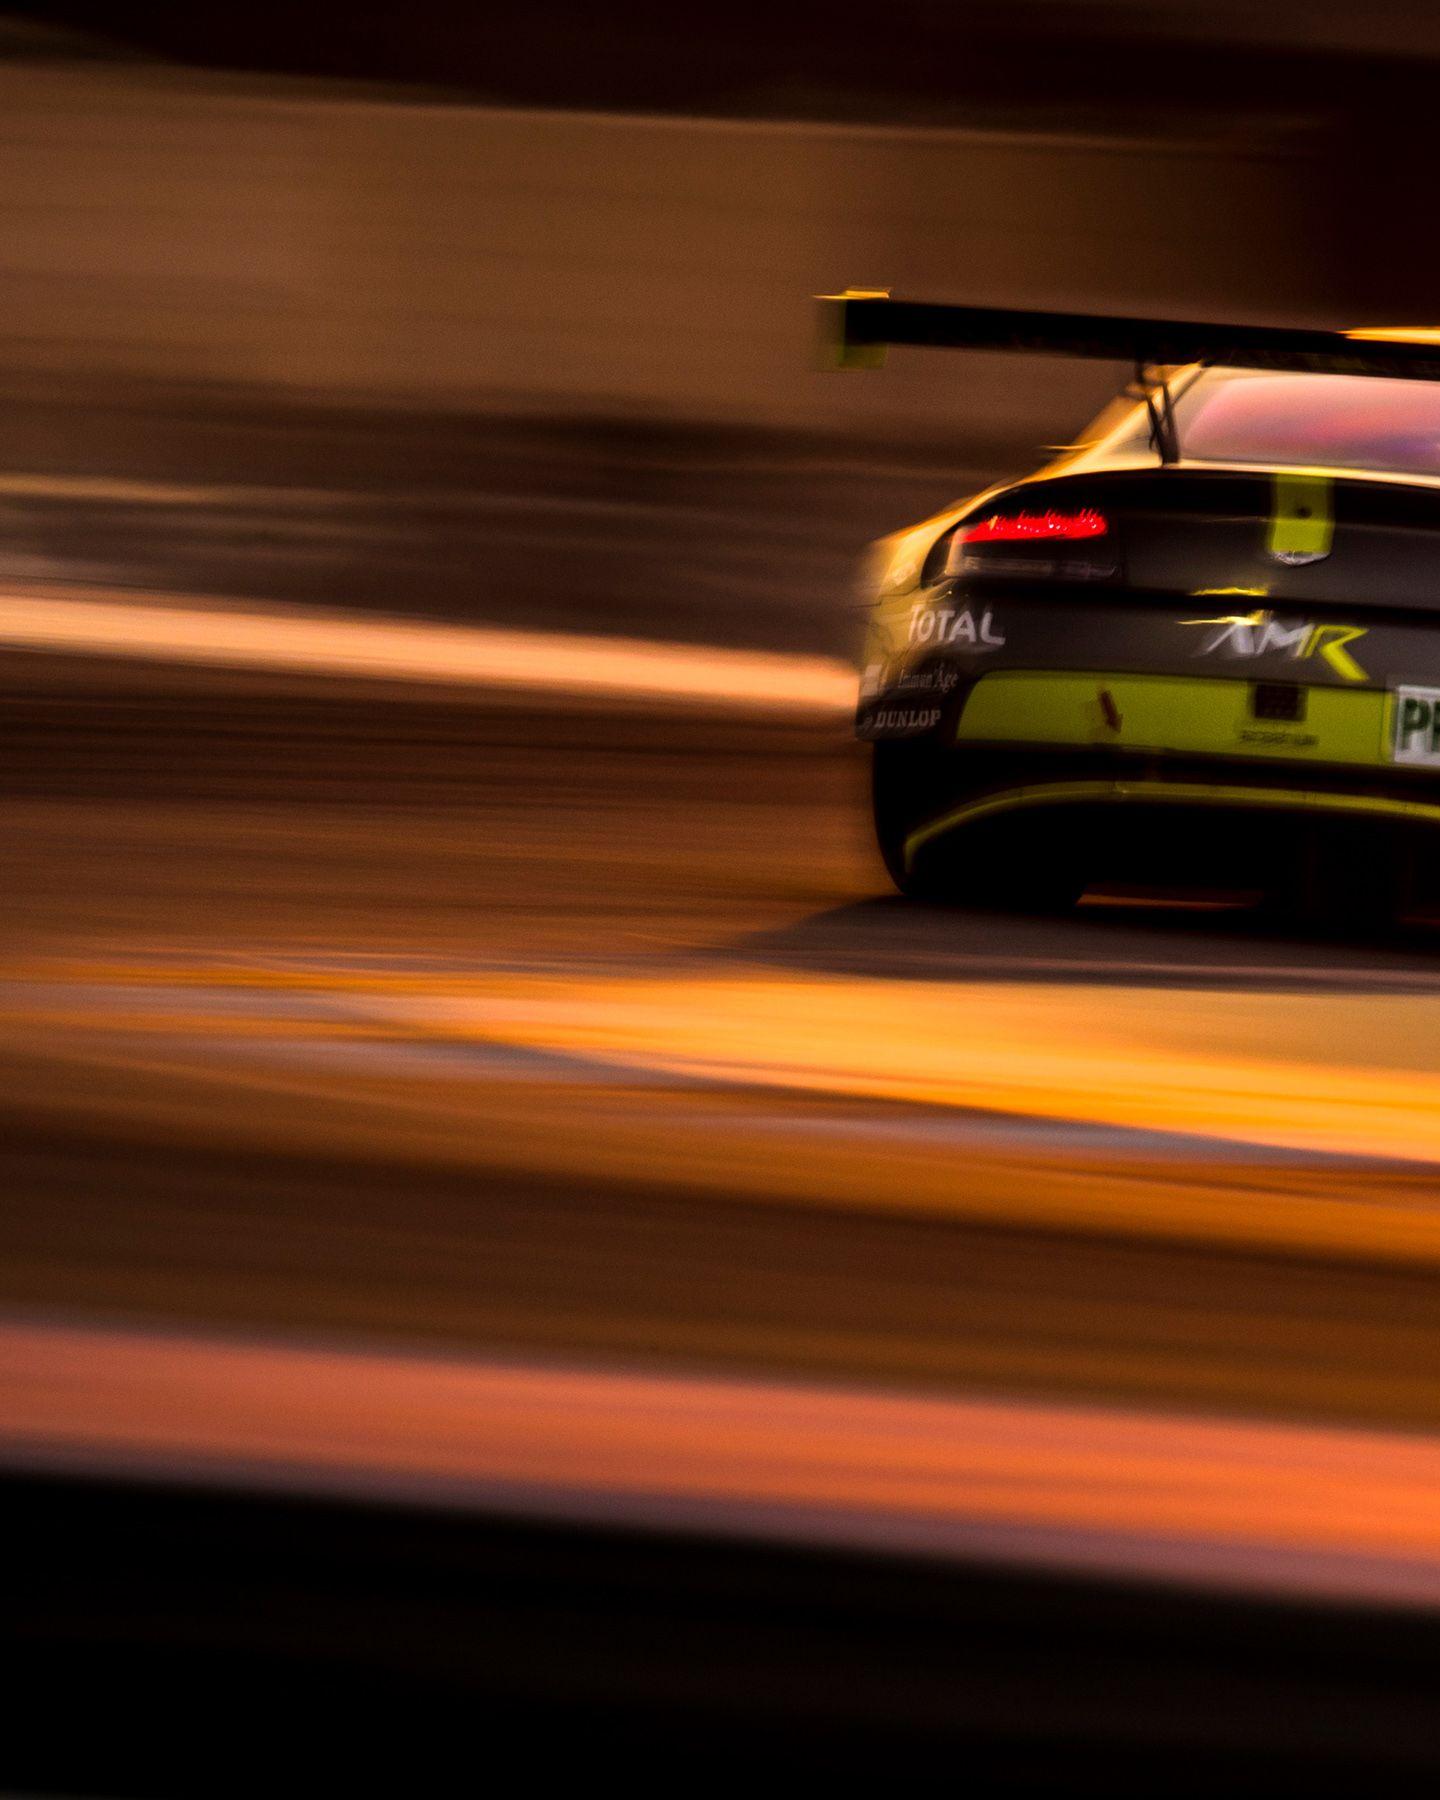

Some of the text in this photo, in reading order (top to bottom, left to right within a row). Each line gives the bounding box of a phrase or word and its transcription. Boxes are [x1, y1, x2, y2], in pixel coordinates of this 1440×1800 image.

[907, 603, 1006, 646] TOTAL
[1202, 622, 1369, 681] AMR
[874, 709, 942, 729] DUNLOP
